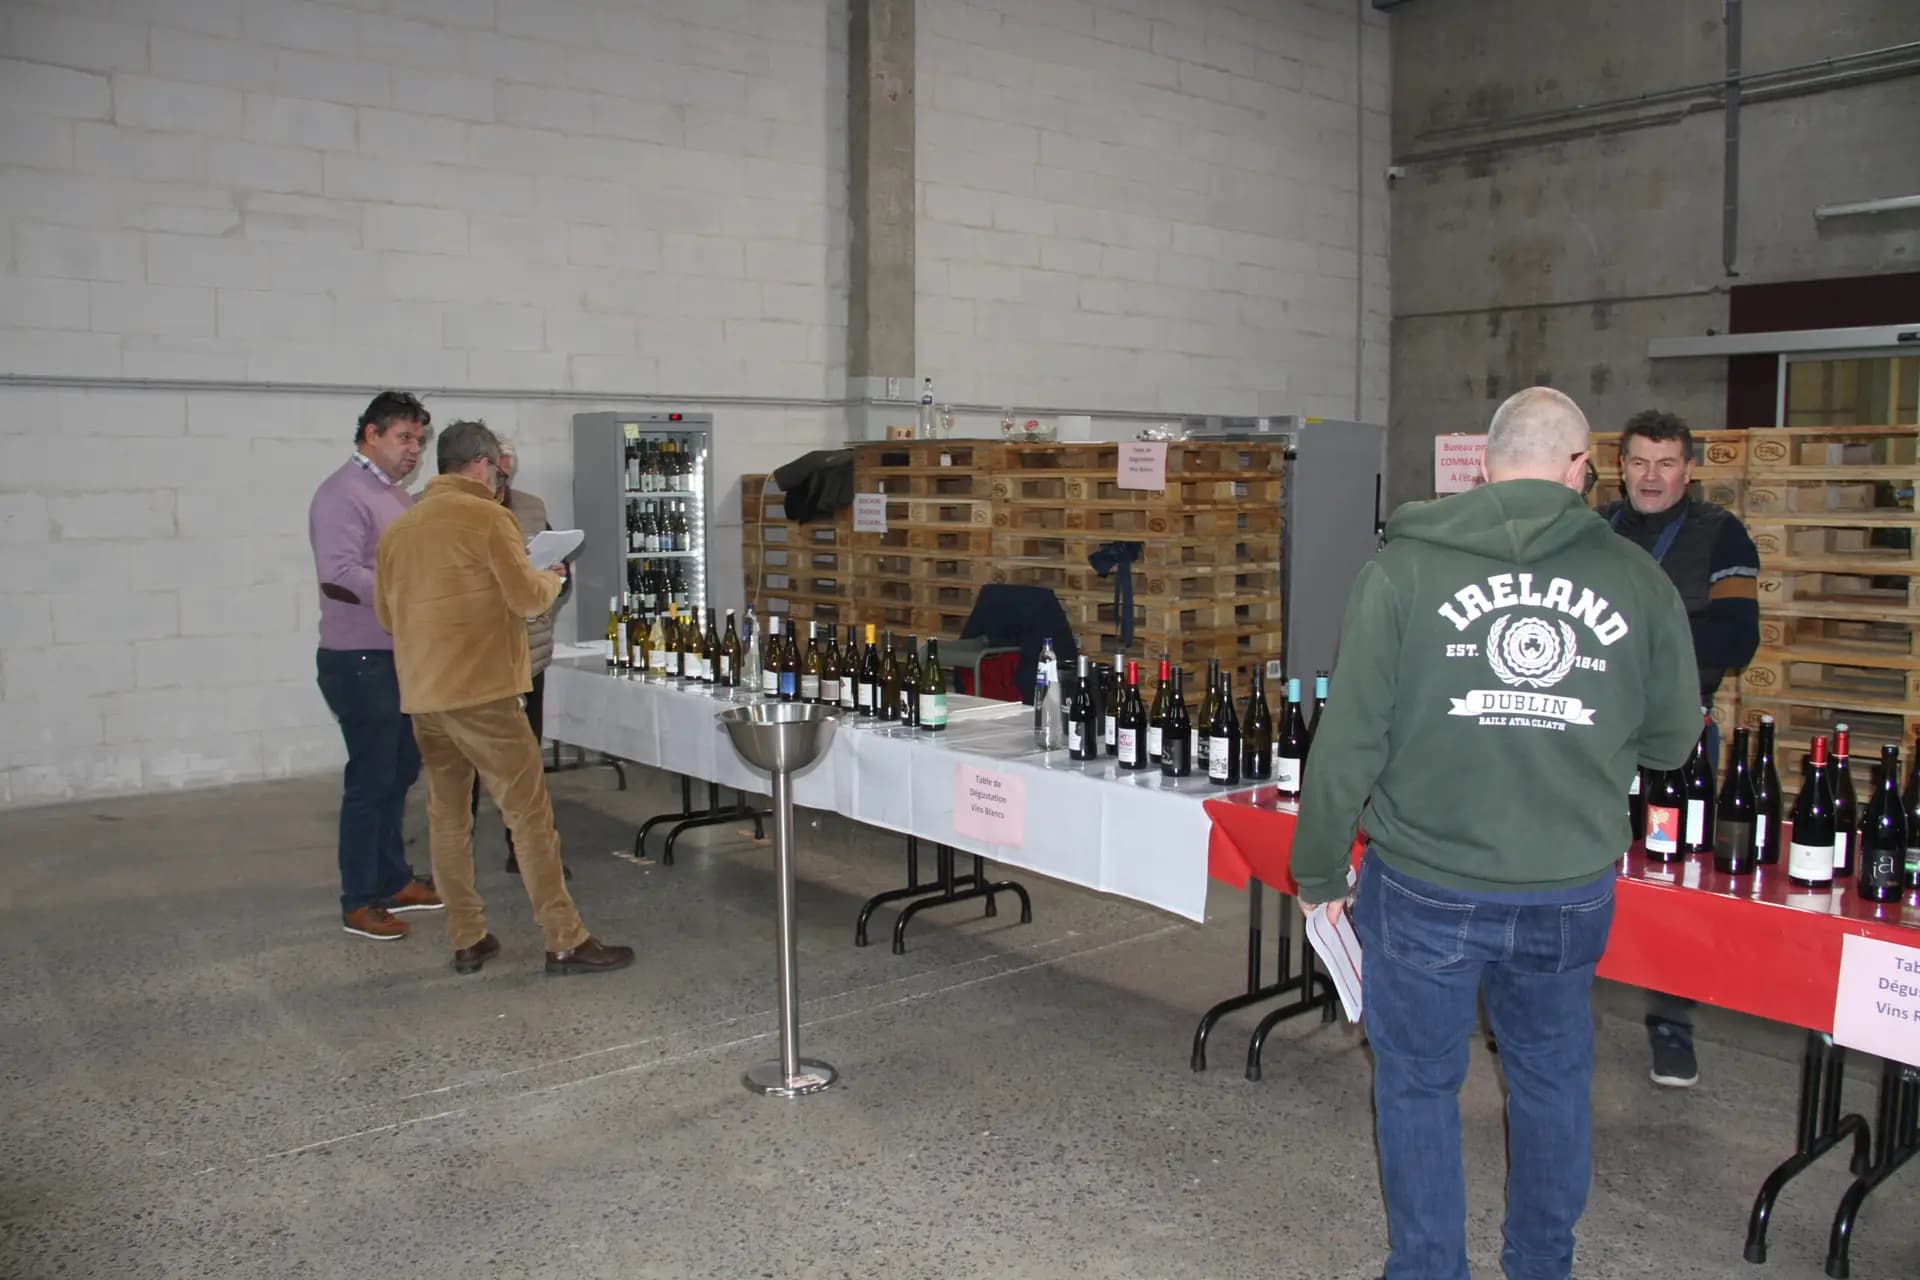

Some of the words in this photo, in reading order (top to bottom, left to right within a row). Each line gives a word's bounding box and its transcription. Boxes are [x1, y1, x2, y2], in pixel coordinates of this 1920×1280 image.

[1440, 457, 1481, 467] COMMAN
[1438, 573, 1628, 646] IRELAND
[1446, 644, 1480, 657] EST.
[1481, 693, 1569, 716] DUBLIN
[1478, 716, 1507, 726] BAILE
[1531, 718, 1566, 731] CLIATH
[975, 775, 992, 786] Table
[993, 779, 1002, 788] de
[970, 804, 984, 814] Vins
[984, 807, 1004, 819] Blancs
[1876, 1000, 1909, 1021] Vins
